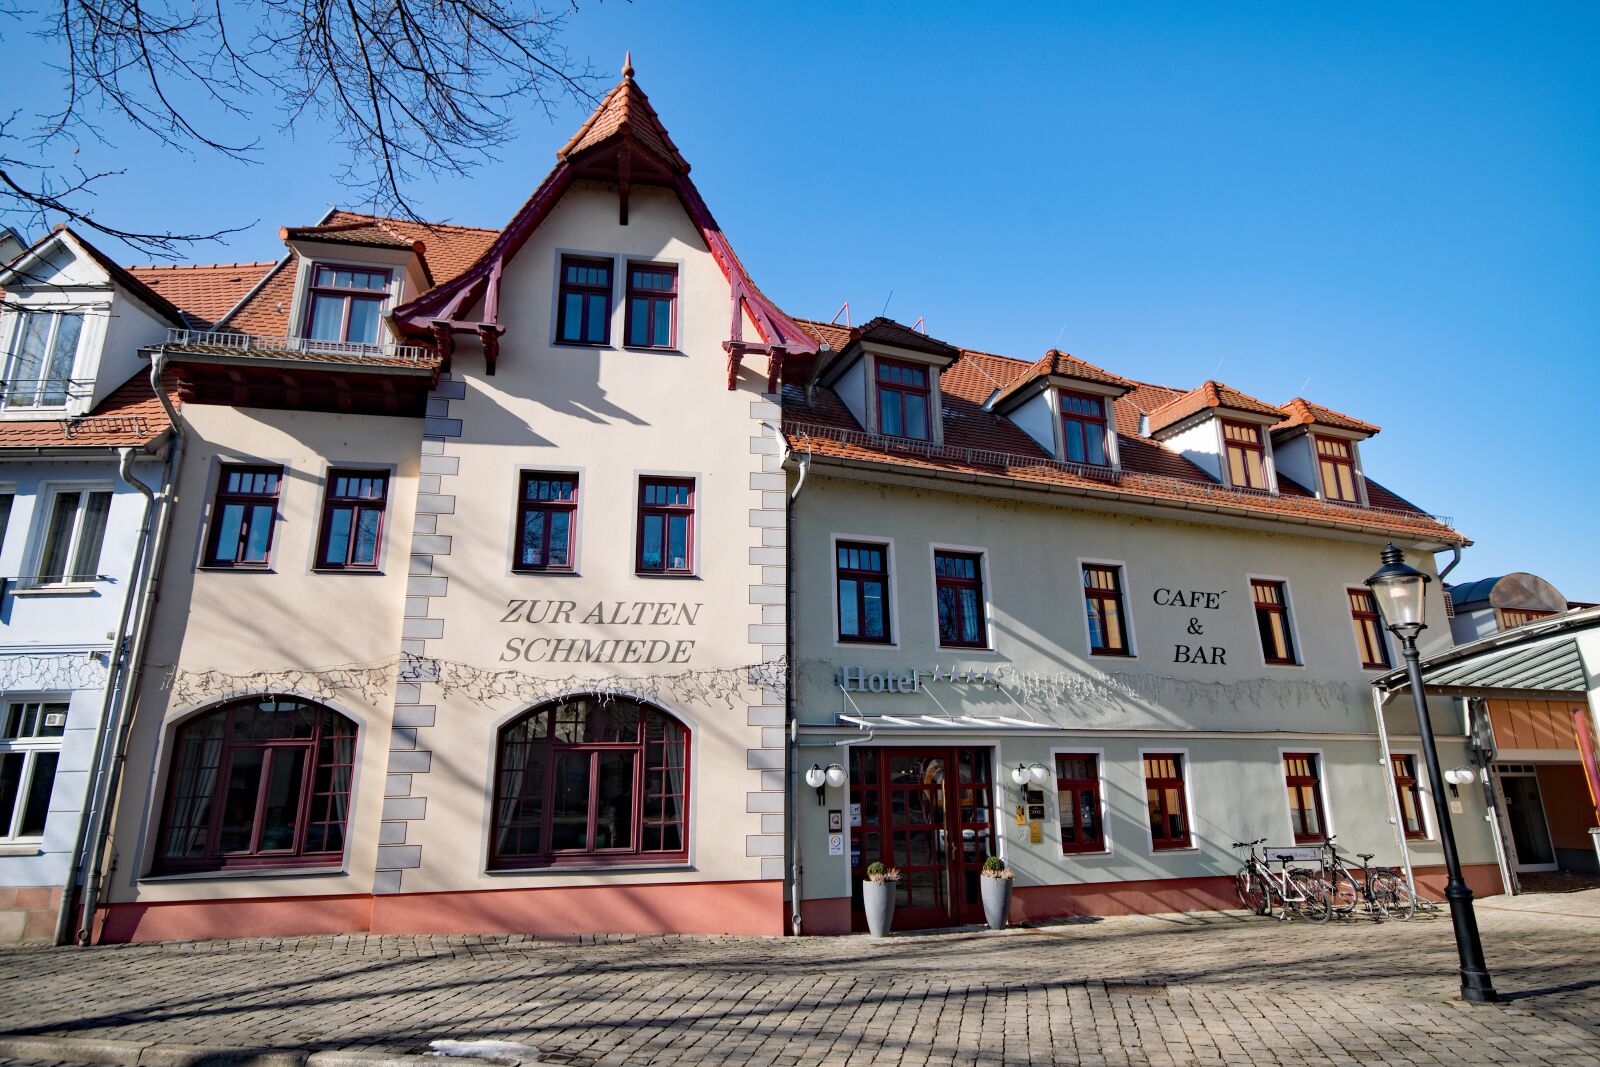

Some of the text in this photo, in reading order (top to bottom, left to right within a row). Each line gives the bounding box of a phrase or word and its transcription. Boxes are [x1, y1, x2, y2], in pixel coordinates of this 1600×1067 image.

[499, 599, 704, 626] ZUR ALTEN
[1186, 617, 1204, 635] &
[498, 637, 696, 664] SCHMIEDE
[1172, 644, 1227, 666] BAR
[841, 664, 921, 694] Hotel
